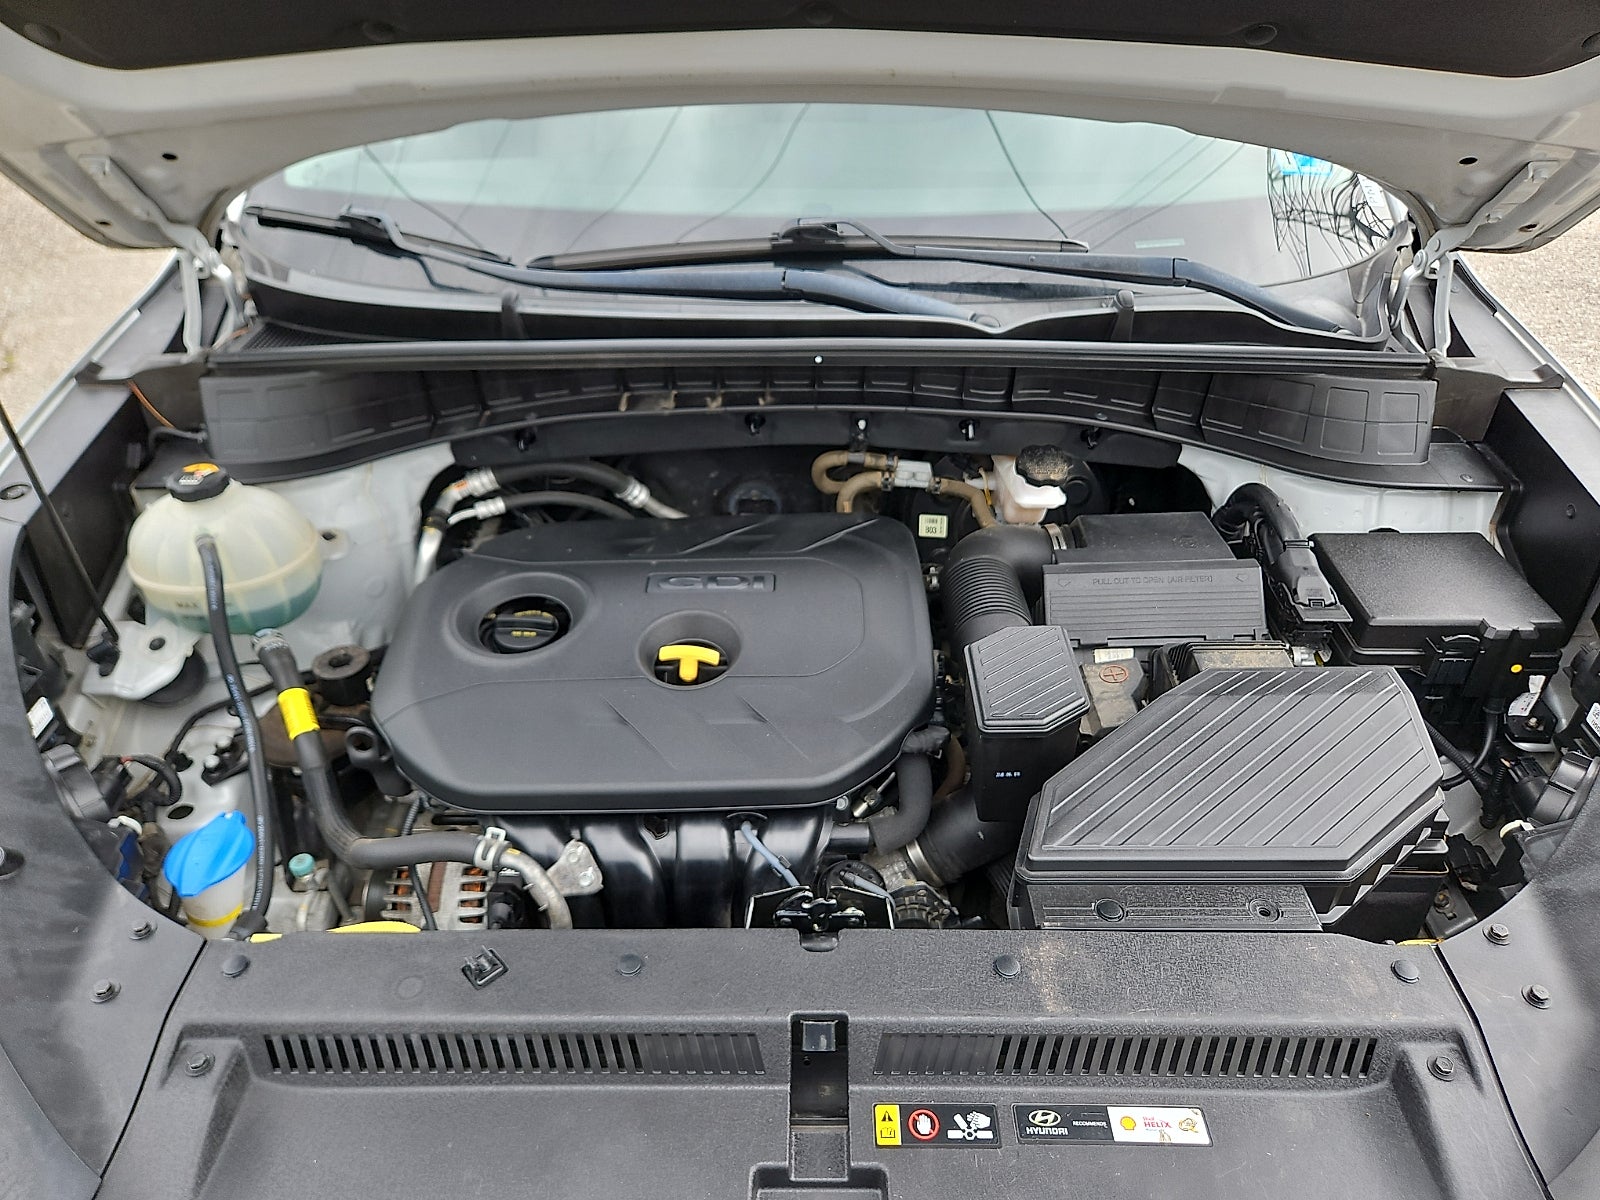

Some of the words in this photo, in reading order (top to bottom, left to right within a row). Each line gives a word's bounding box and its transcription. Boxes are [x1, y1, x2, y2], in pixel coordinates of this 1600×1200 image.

[659, 575, 765, 590] GDI
[1092, 577, 1112, 585] PULL
[1114, 577, 1129, 585] OUT
[1130, 576, 1141, 584] TO
[1143, 576, 1164, 584] OPEN
[1144, 1120, 1173, 1129] HELIX
[1025, 1126, 1069, 1136] HYUNDAI
